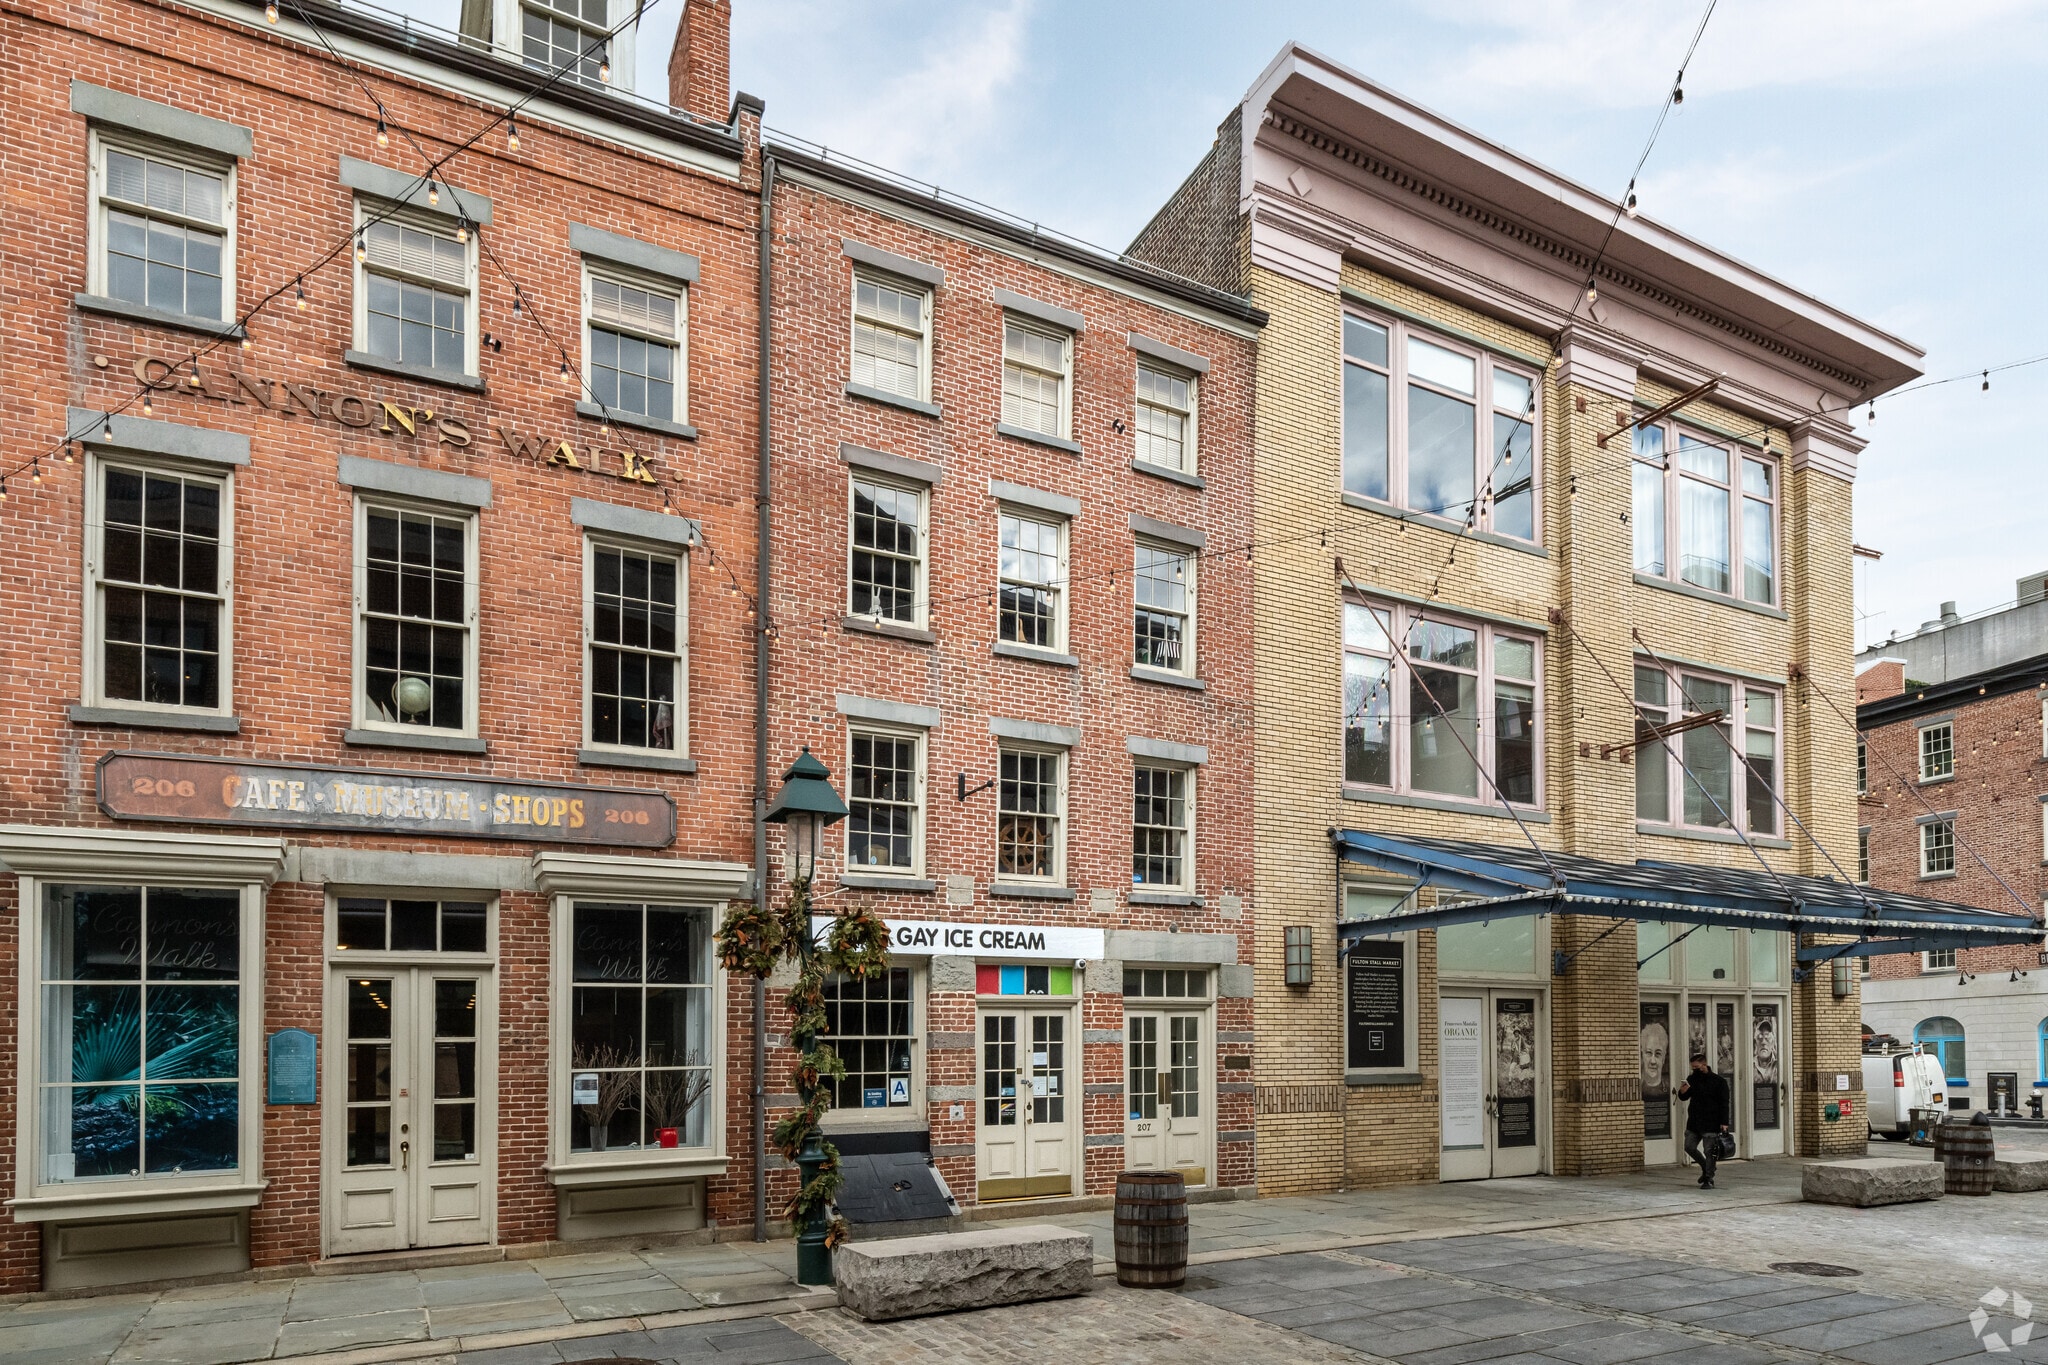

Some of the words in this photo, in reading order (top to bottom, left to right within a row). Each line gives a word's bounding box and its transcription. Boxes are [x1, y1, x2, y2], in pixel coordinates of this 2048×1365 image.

[133, 356, 472, 447] CANNON'S
[497, 426, 659, 484] WALK
[132, 777, 196, 798] 206
[222, 774, 305, 812] CAFE
[333, 780, 471, 821] MUSEUM
[492, 793, 586, 829] SHOPS
[604, 808, 650, 825] 206
[896, 926, 939, 947] GAY
[944, 929, 973, 949] ICE
[979, 930, 1046, 951] CREAM
[120, 936, 217, 969] Walk
[598, 955, 668, 981] Walk
[1444, 1027, 1478, 1036] ORGANIC
[893, 1081, 905, 1095] A
[1137, 1123, 1151, 1131] 207
